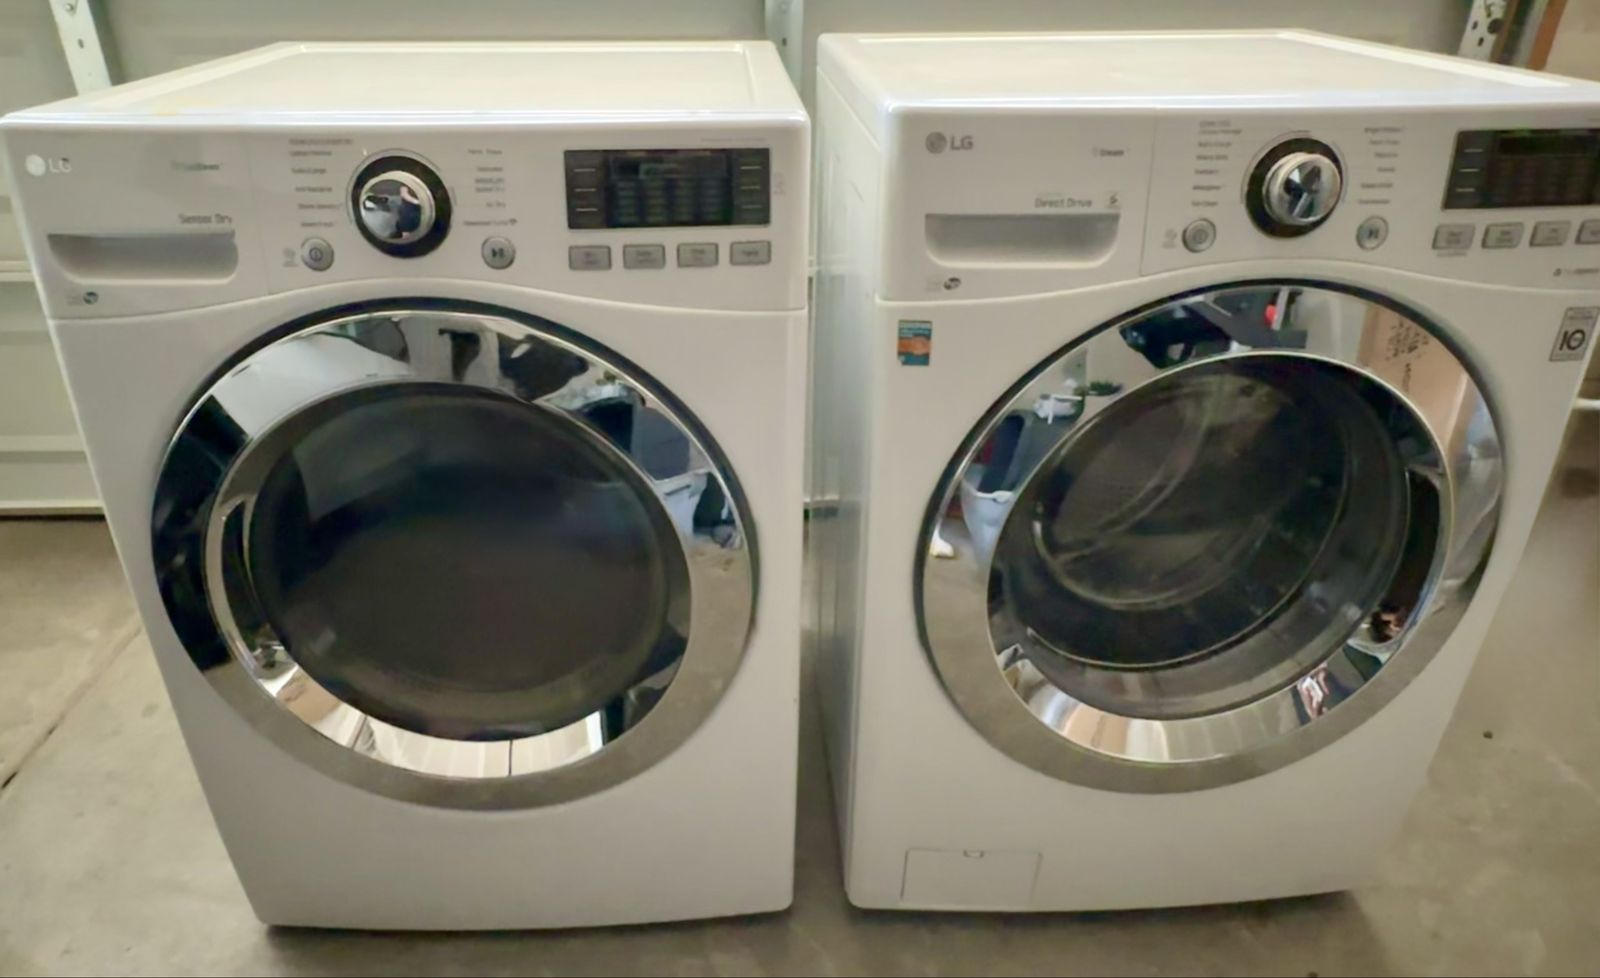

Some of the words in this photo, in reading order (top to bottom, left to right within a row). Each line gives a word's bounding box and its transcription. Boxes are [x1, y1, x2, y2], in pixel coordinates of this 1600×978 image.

[951, 135, 974, 151] LG
[49, 157, 72, 173] LG
[1034, 197, 1065, 208] Direct
[1066, 197, 1093, 208] Drive
